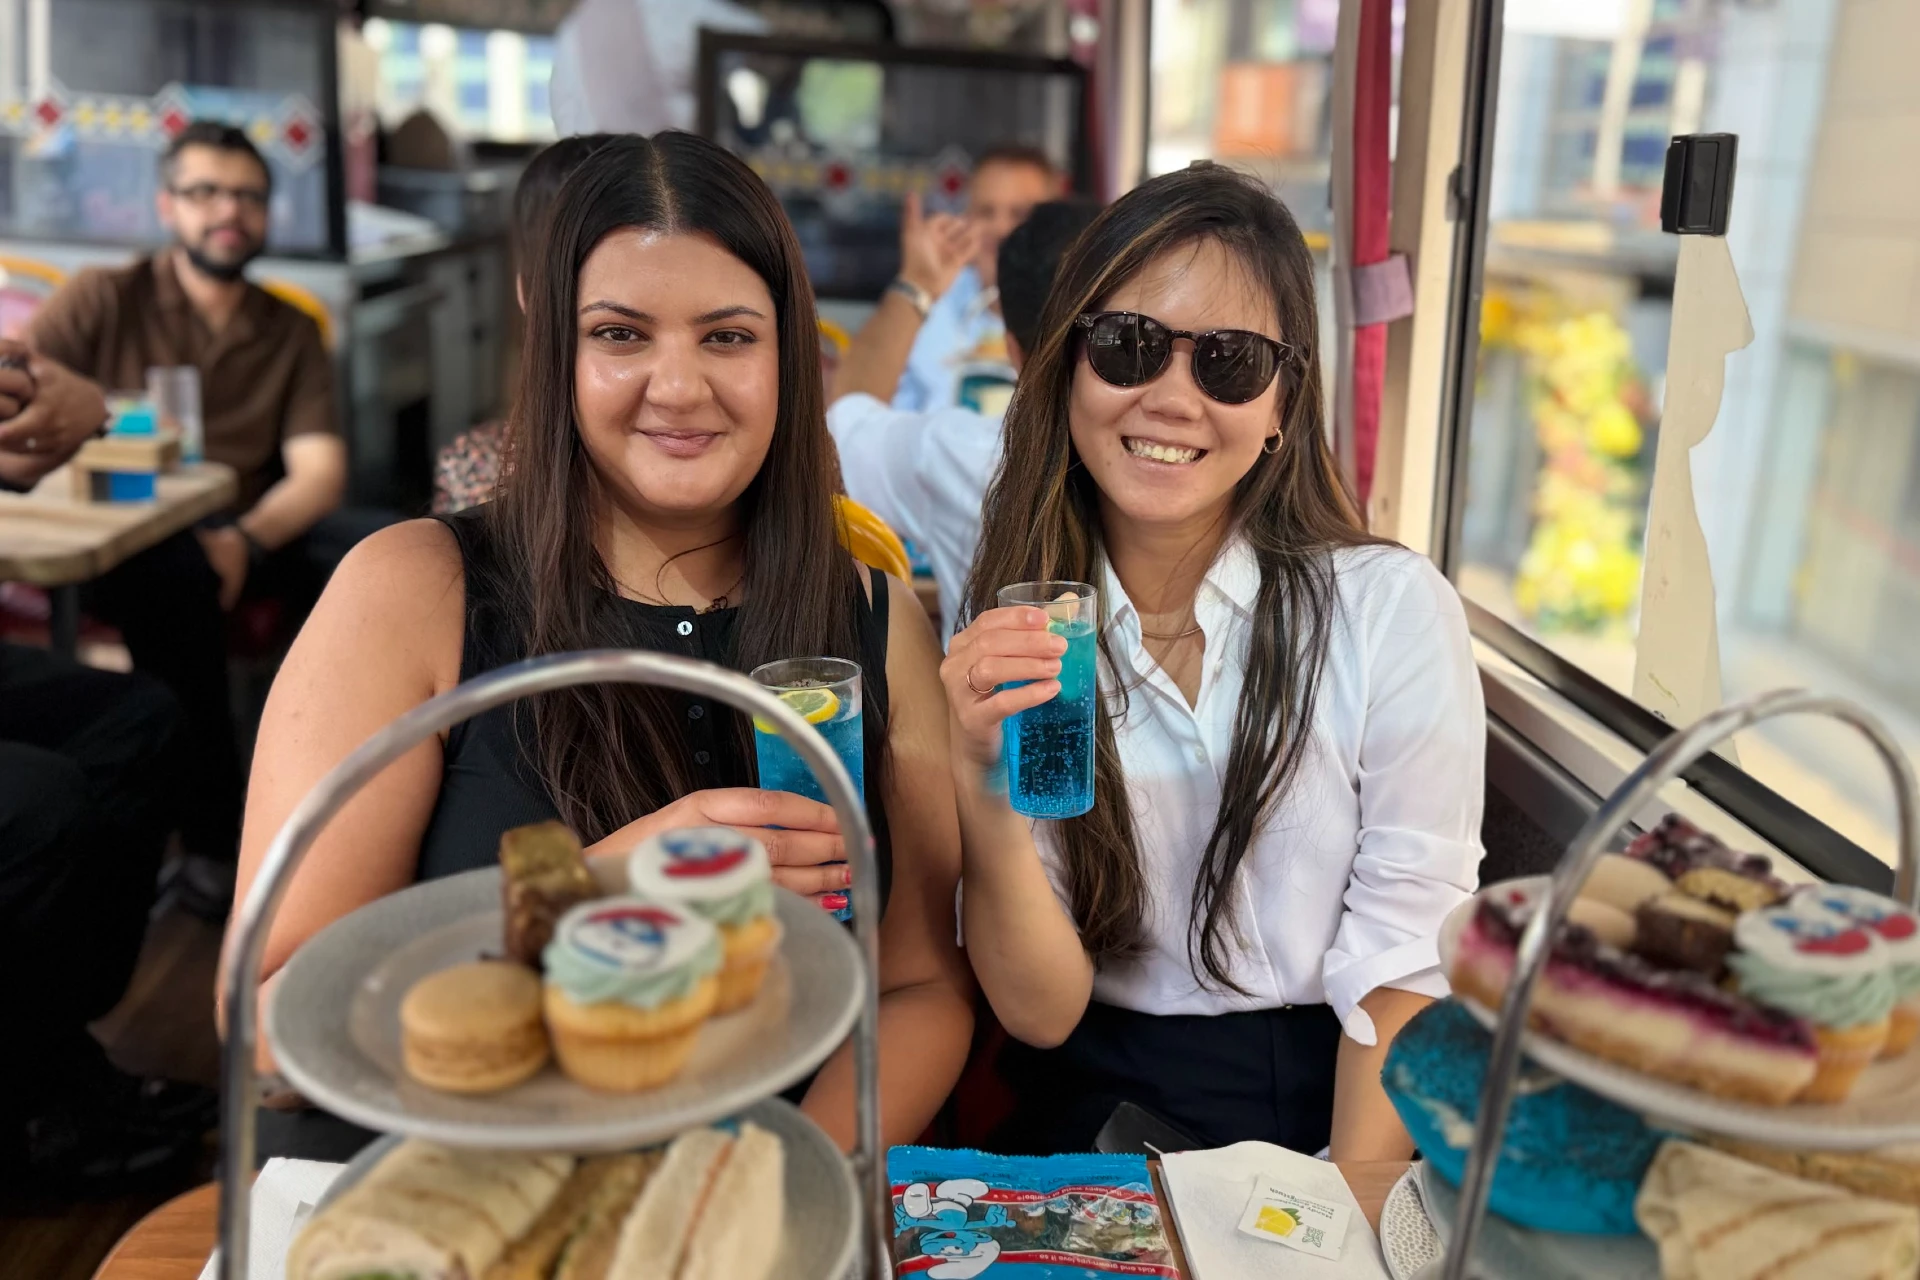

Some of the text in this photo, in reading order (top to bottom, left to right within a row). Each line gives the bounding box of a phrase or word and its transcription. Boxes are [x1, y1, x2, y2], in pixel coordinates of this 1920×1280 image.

[1061, 1186, 1082, 1194] world
[1058, 1255, 1075, 1263] love
[1077, 1257, 1119, 1269] grown-ups
